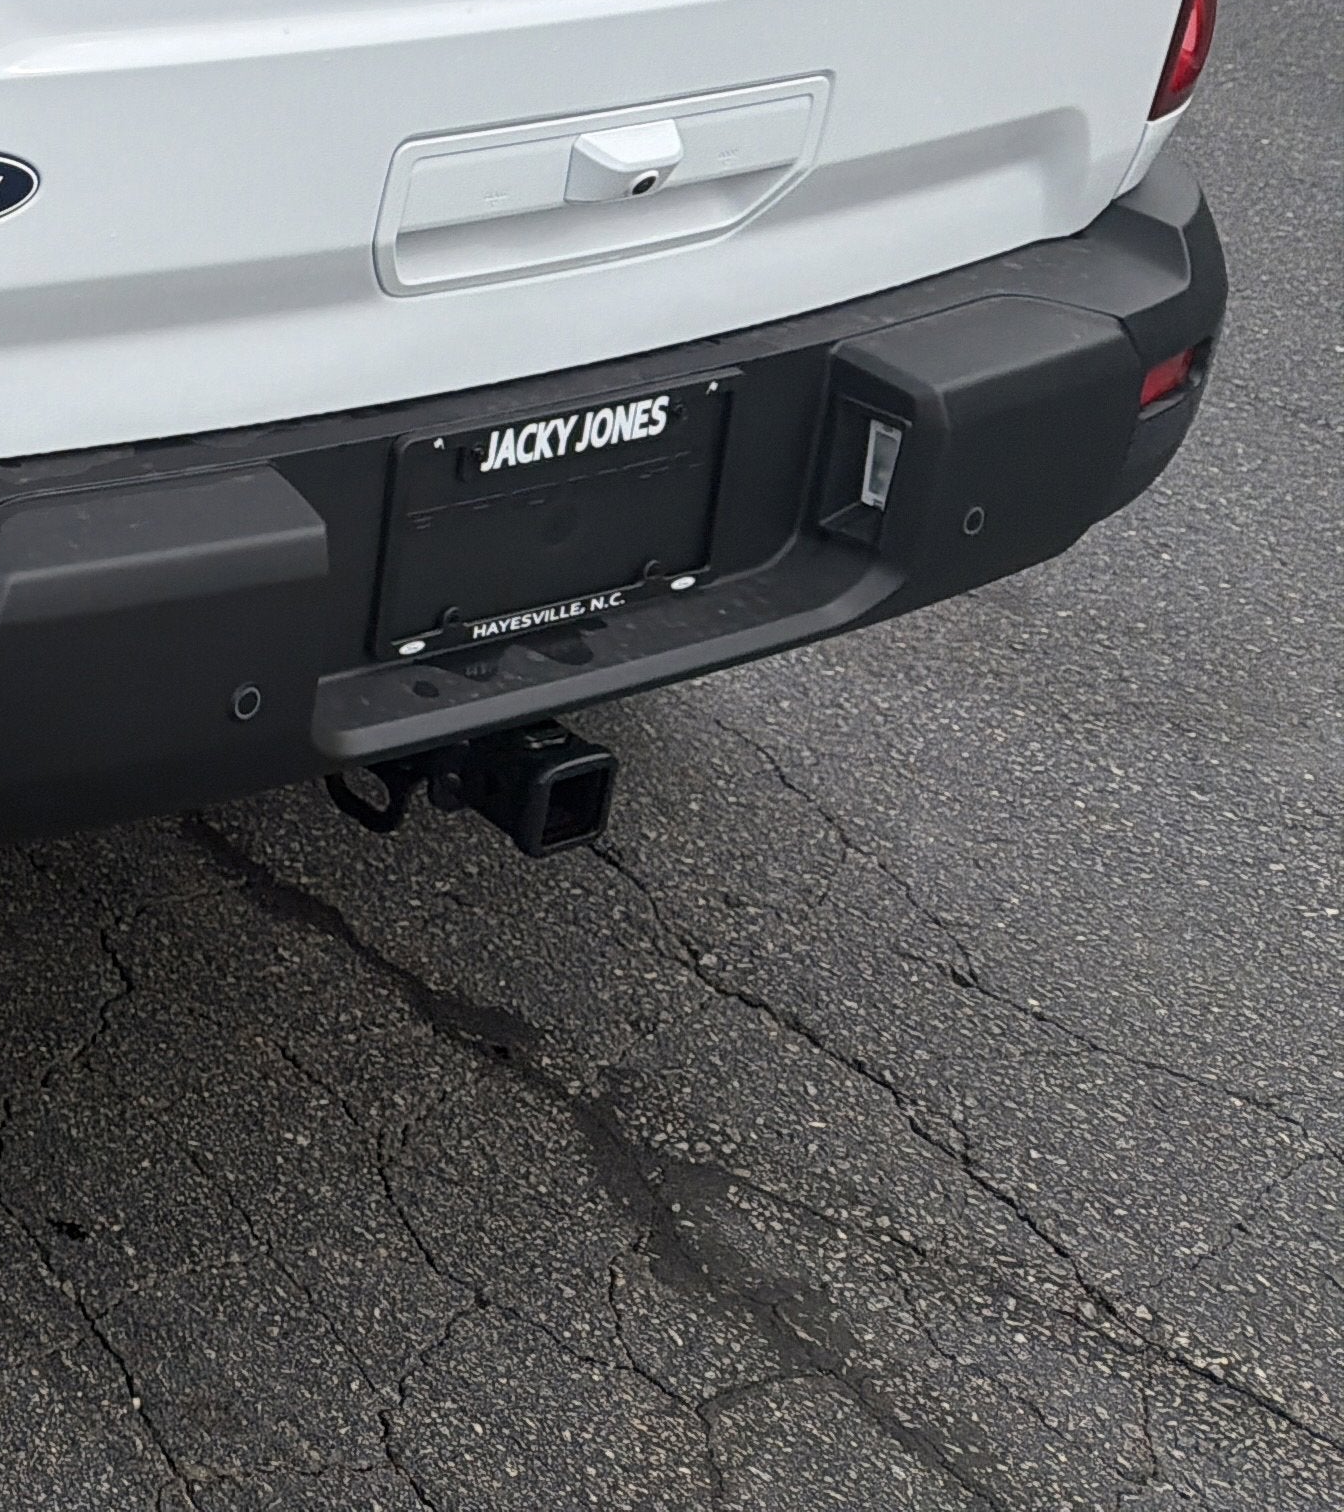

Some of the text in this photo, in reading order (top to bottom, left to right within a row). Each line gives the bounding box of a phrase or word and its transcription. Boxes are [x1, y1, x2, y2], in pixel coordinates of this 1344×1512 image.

[480, 395, 670, 472] JACKY JONES
[472, 592, 625, 639] HAYESVILLE, N.C.
